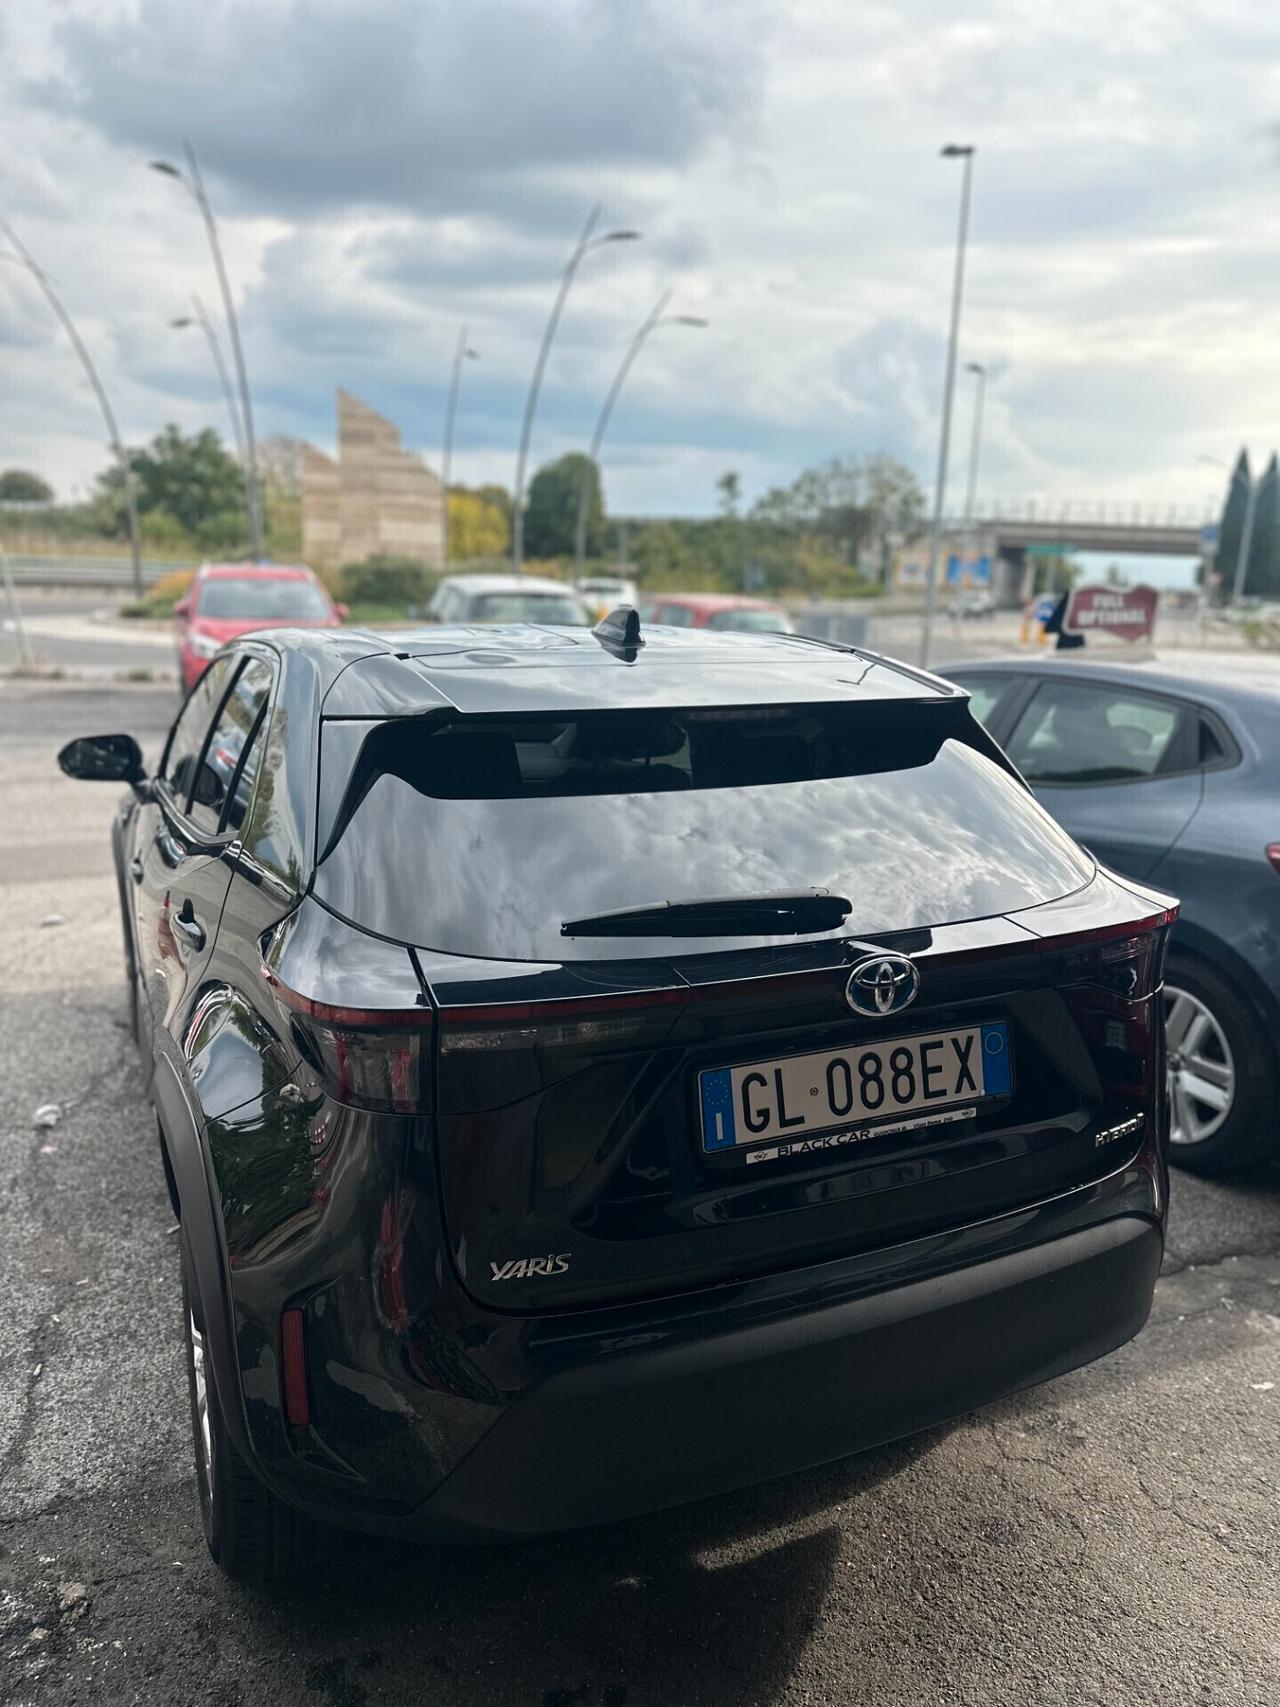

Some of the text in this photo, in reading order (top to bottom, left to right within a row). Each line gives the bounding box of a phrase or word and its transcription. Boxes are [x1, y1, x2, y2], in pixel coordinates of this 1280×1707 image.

[716, 1112, 724, 1140] I
[777, 1136, 834, 1157] BLACK
[836, 1129, 871, 1145] CAR
